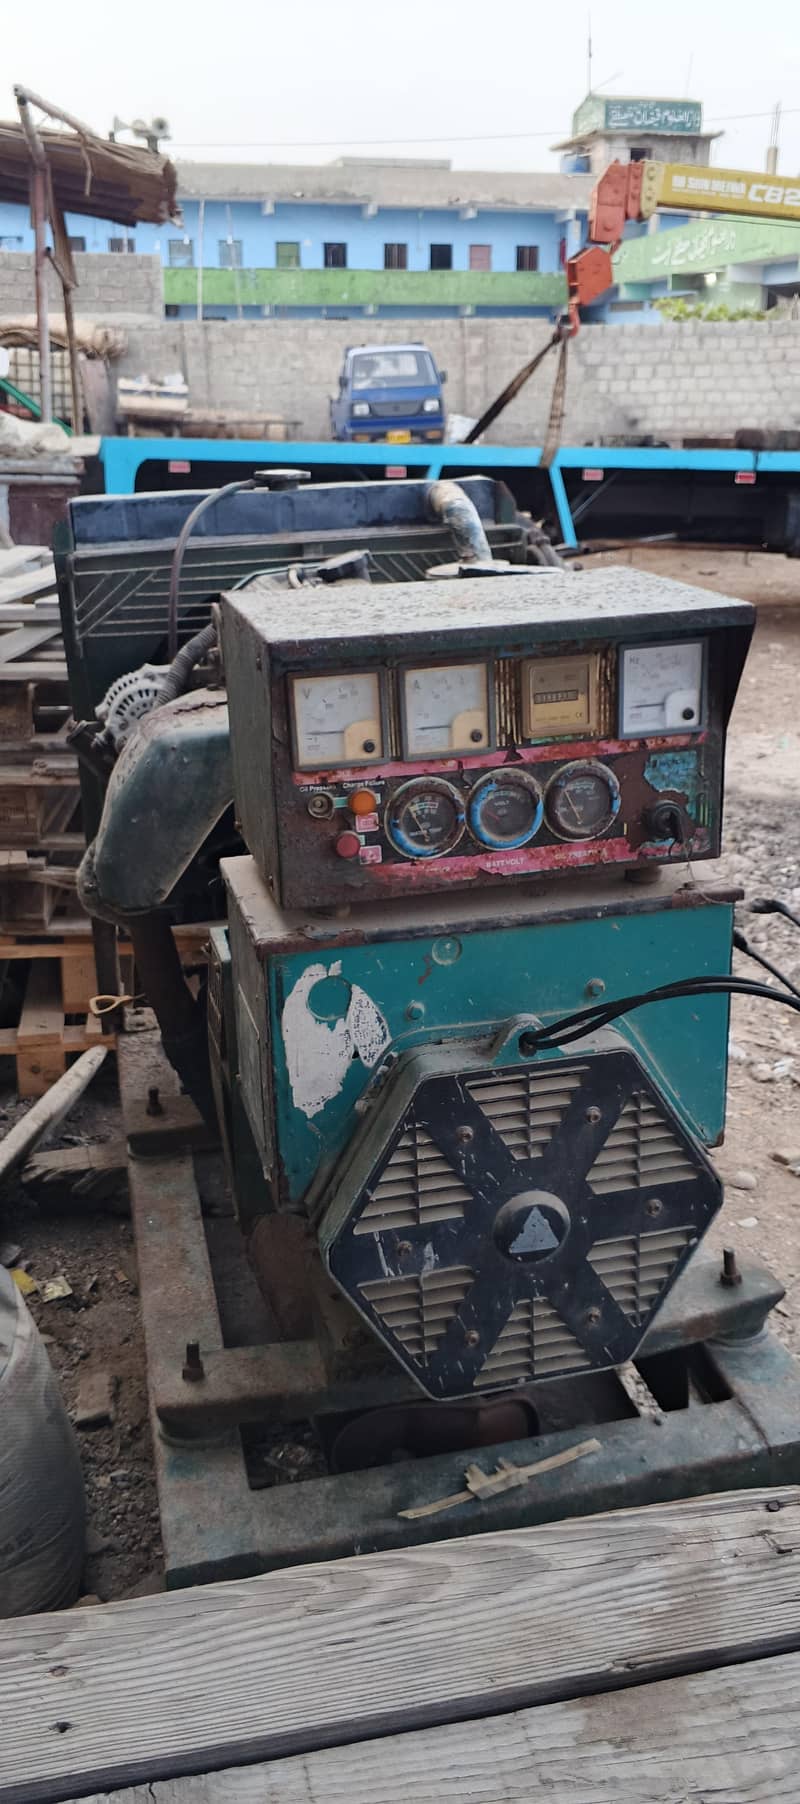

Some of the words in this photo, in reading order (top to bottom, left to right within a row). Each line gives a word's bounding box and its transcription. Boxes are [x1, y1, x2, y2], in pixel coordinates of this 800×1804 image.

[629, 655, 640, 665] Hz
[413, 679, 422, 690] A
[302, 687, 312, 699] V
[365, 778, 386, 788] Failure
